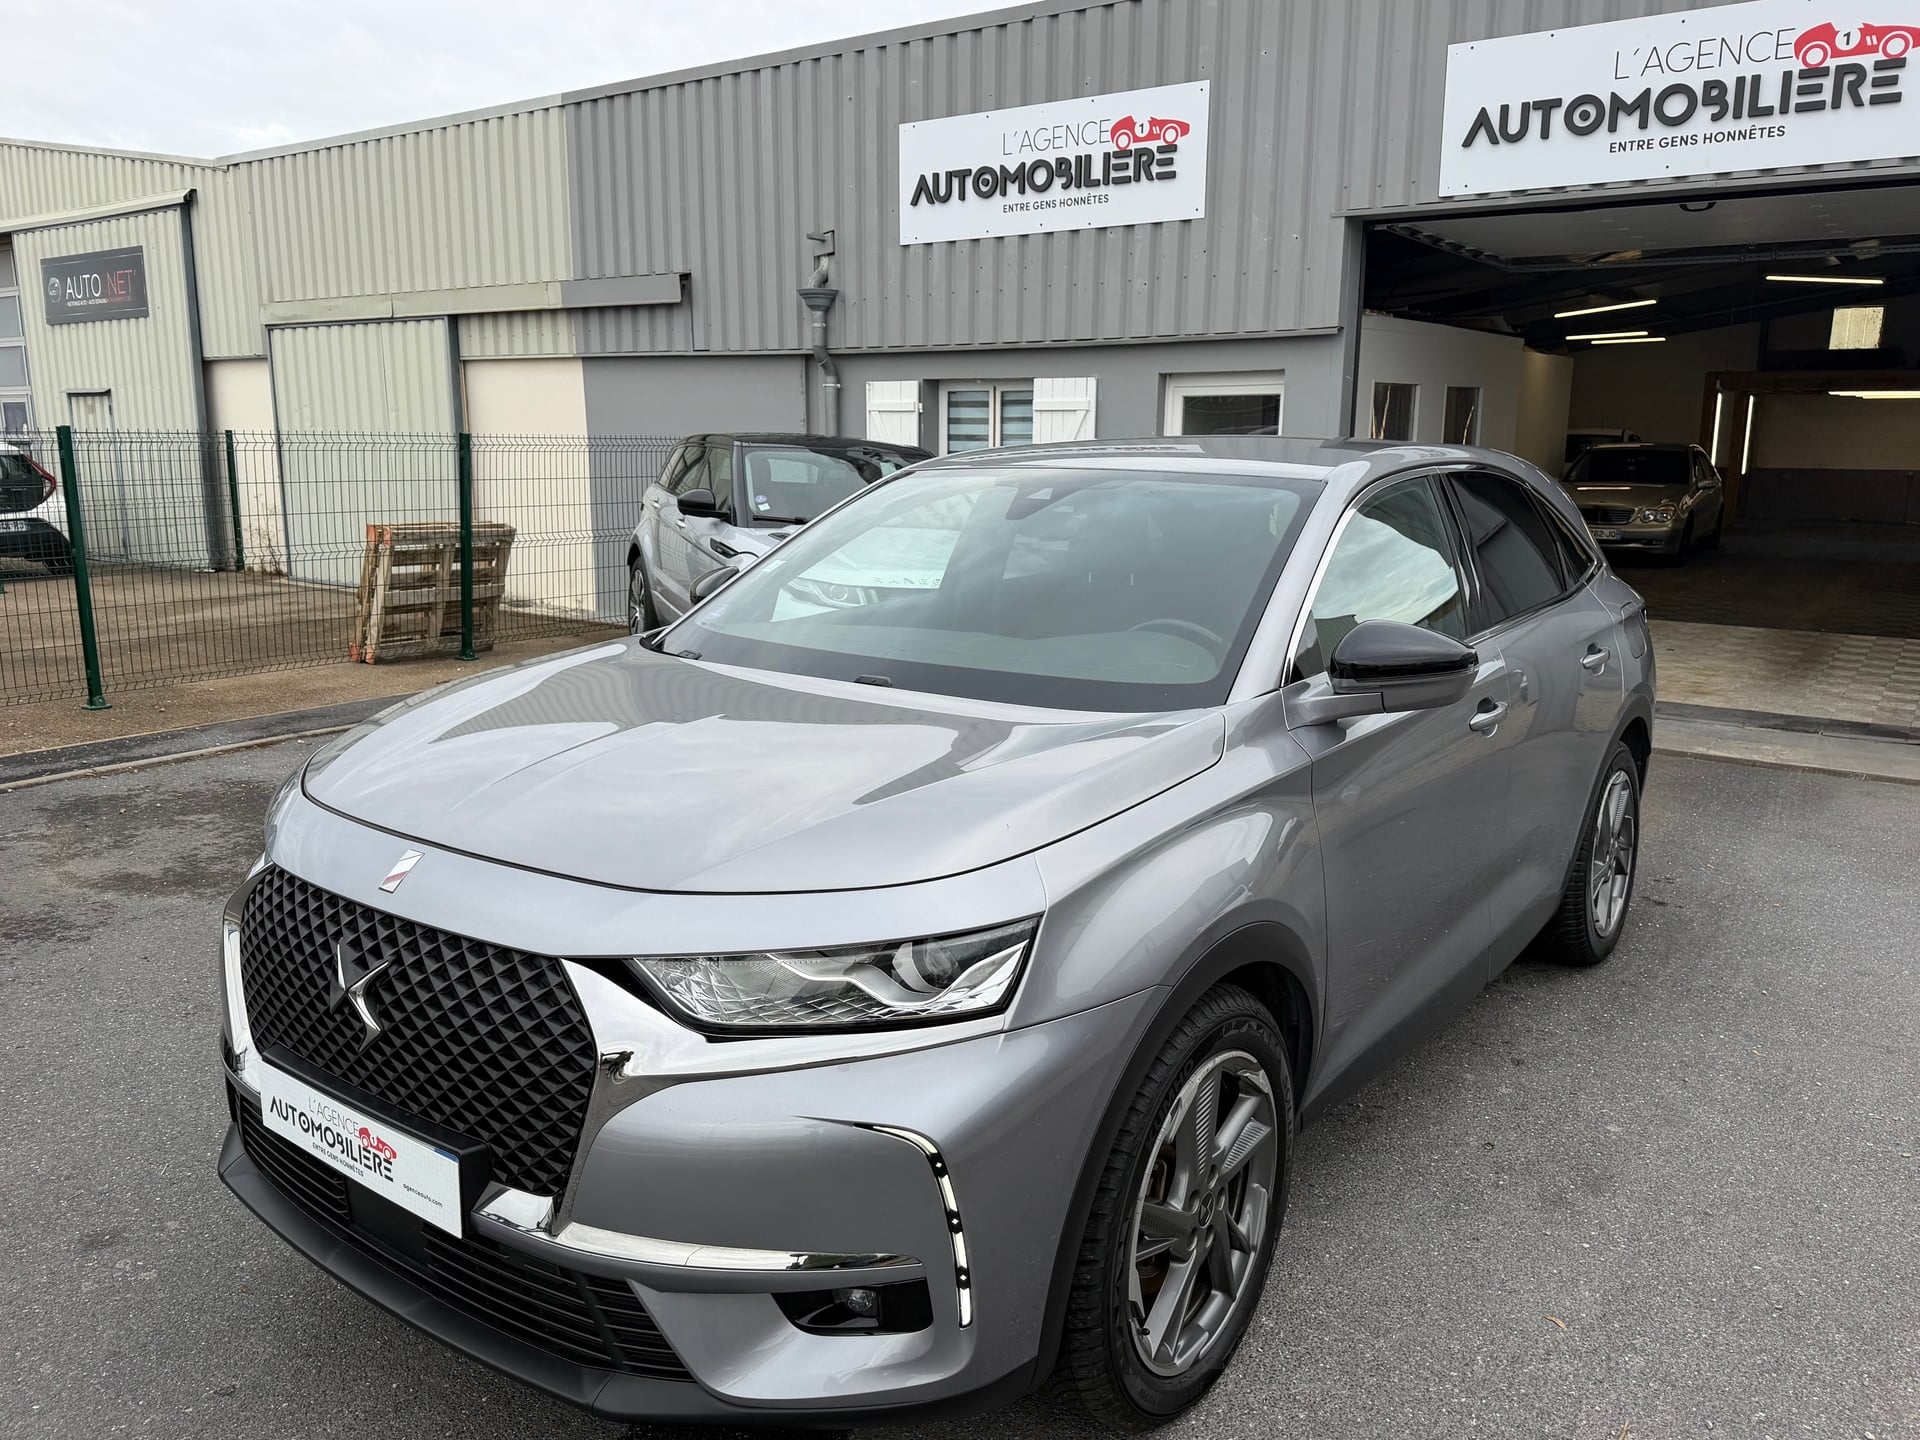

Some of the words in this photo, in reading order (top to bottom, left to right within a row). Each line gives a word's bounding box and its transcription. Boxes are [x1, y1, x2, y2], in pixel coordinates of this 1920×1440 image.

[1614, 27, 1797, 80] L'AGENCE
[1002, 118, 1112, 156] L'AGENCE
[1609, 138, 1655, 154] ENTRE
[1658, 134, 1699, 149] GENS
[1702, 124, 1786, 145] HONNÊTES
[1002, 201, 1031, 213] ENTRE
[1032, 198, 1057, 210] GENS
[1059, 193, 1109, 208] HONNÊTES
[65, 273, 102, 300] AUTO
[308, 1096, 360, 1139] L'AGENCE
[1145, 1058, 1195, 1152] KUMHO
[312, 1142, 326, 1156] ENTRE
